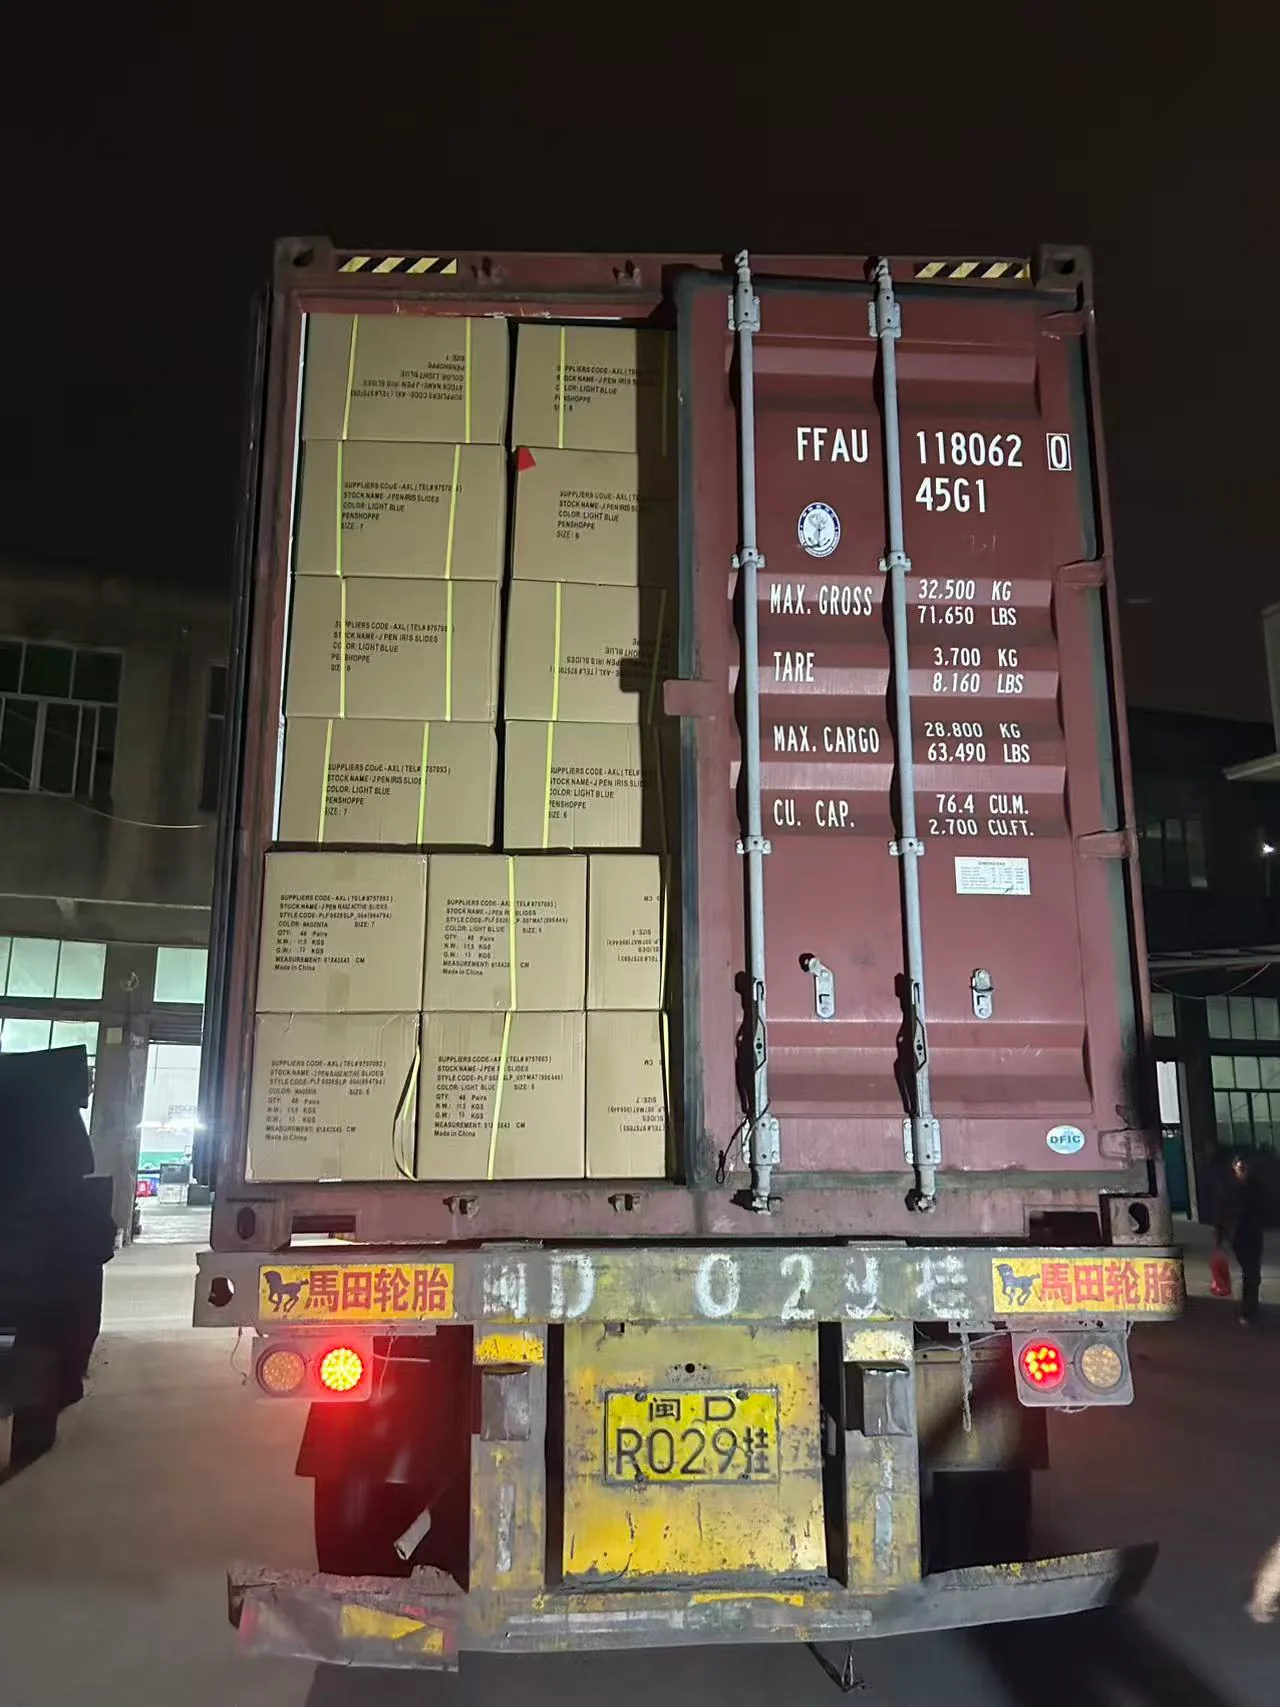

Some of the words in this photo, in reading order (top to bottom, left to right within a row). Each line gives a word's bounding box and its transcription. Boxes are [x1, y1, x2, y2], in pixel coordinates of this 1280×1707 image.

[797, 427, 868, 462] FFAU
[916, 430, 1023, 467] 118062
[1050, 435, 1068, 469] 0
[915, 477, 986, 513] 45G1
[367, 502, 389, 510] LIGHT
[389, 504, 405, 512] BLUE
[583, 511, 602, 519] LIGHT
[770, 584, 811, 614] MAX.
[819, 585, 873, 616] GROSS
[918, 579, 975, 600] 32,500
[992, 580, 1012, 601] KG
[917, 605, 974, 625] 71,650
[991, 607, 1016, 625] LBS
[358, 643, 379, 651] LIGHT
[380, 644, 399, 652] BLUE
[773, 652, 815, 682] TARE
[933, 647, 980, 667] 3,700
[998, 648, 1017, 667] KG
[932, 672, 980, 692] 8,160
[997, 673, 1024, 693] LBS
[773, 725, 817, 752] MAX.
[823, 726, 879, 753] CARGO
[1000, 723, 1020, 738] KG
[928, 743, 986, 762] 63,490
[1003, 743, 1030, 763] LBS
[351, 786, 373, 794] LIGHT
[374, 787, 391, 795] BLUE
[573, 789, 594, 798] LIGHT
[596, 790, 614, 798] BLUE
[774, 799, 801, 826] CU.
[815, 800, 854, 828] CAP.
[936, 794, 974, 814] 76.4
[989, 795, 1029, 814] CU.M.
[988, 819, 1034, 836] CU.FT.
[615, 1427, 770, 1476] R029挂
